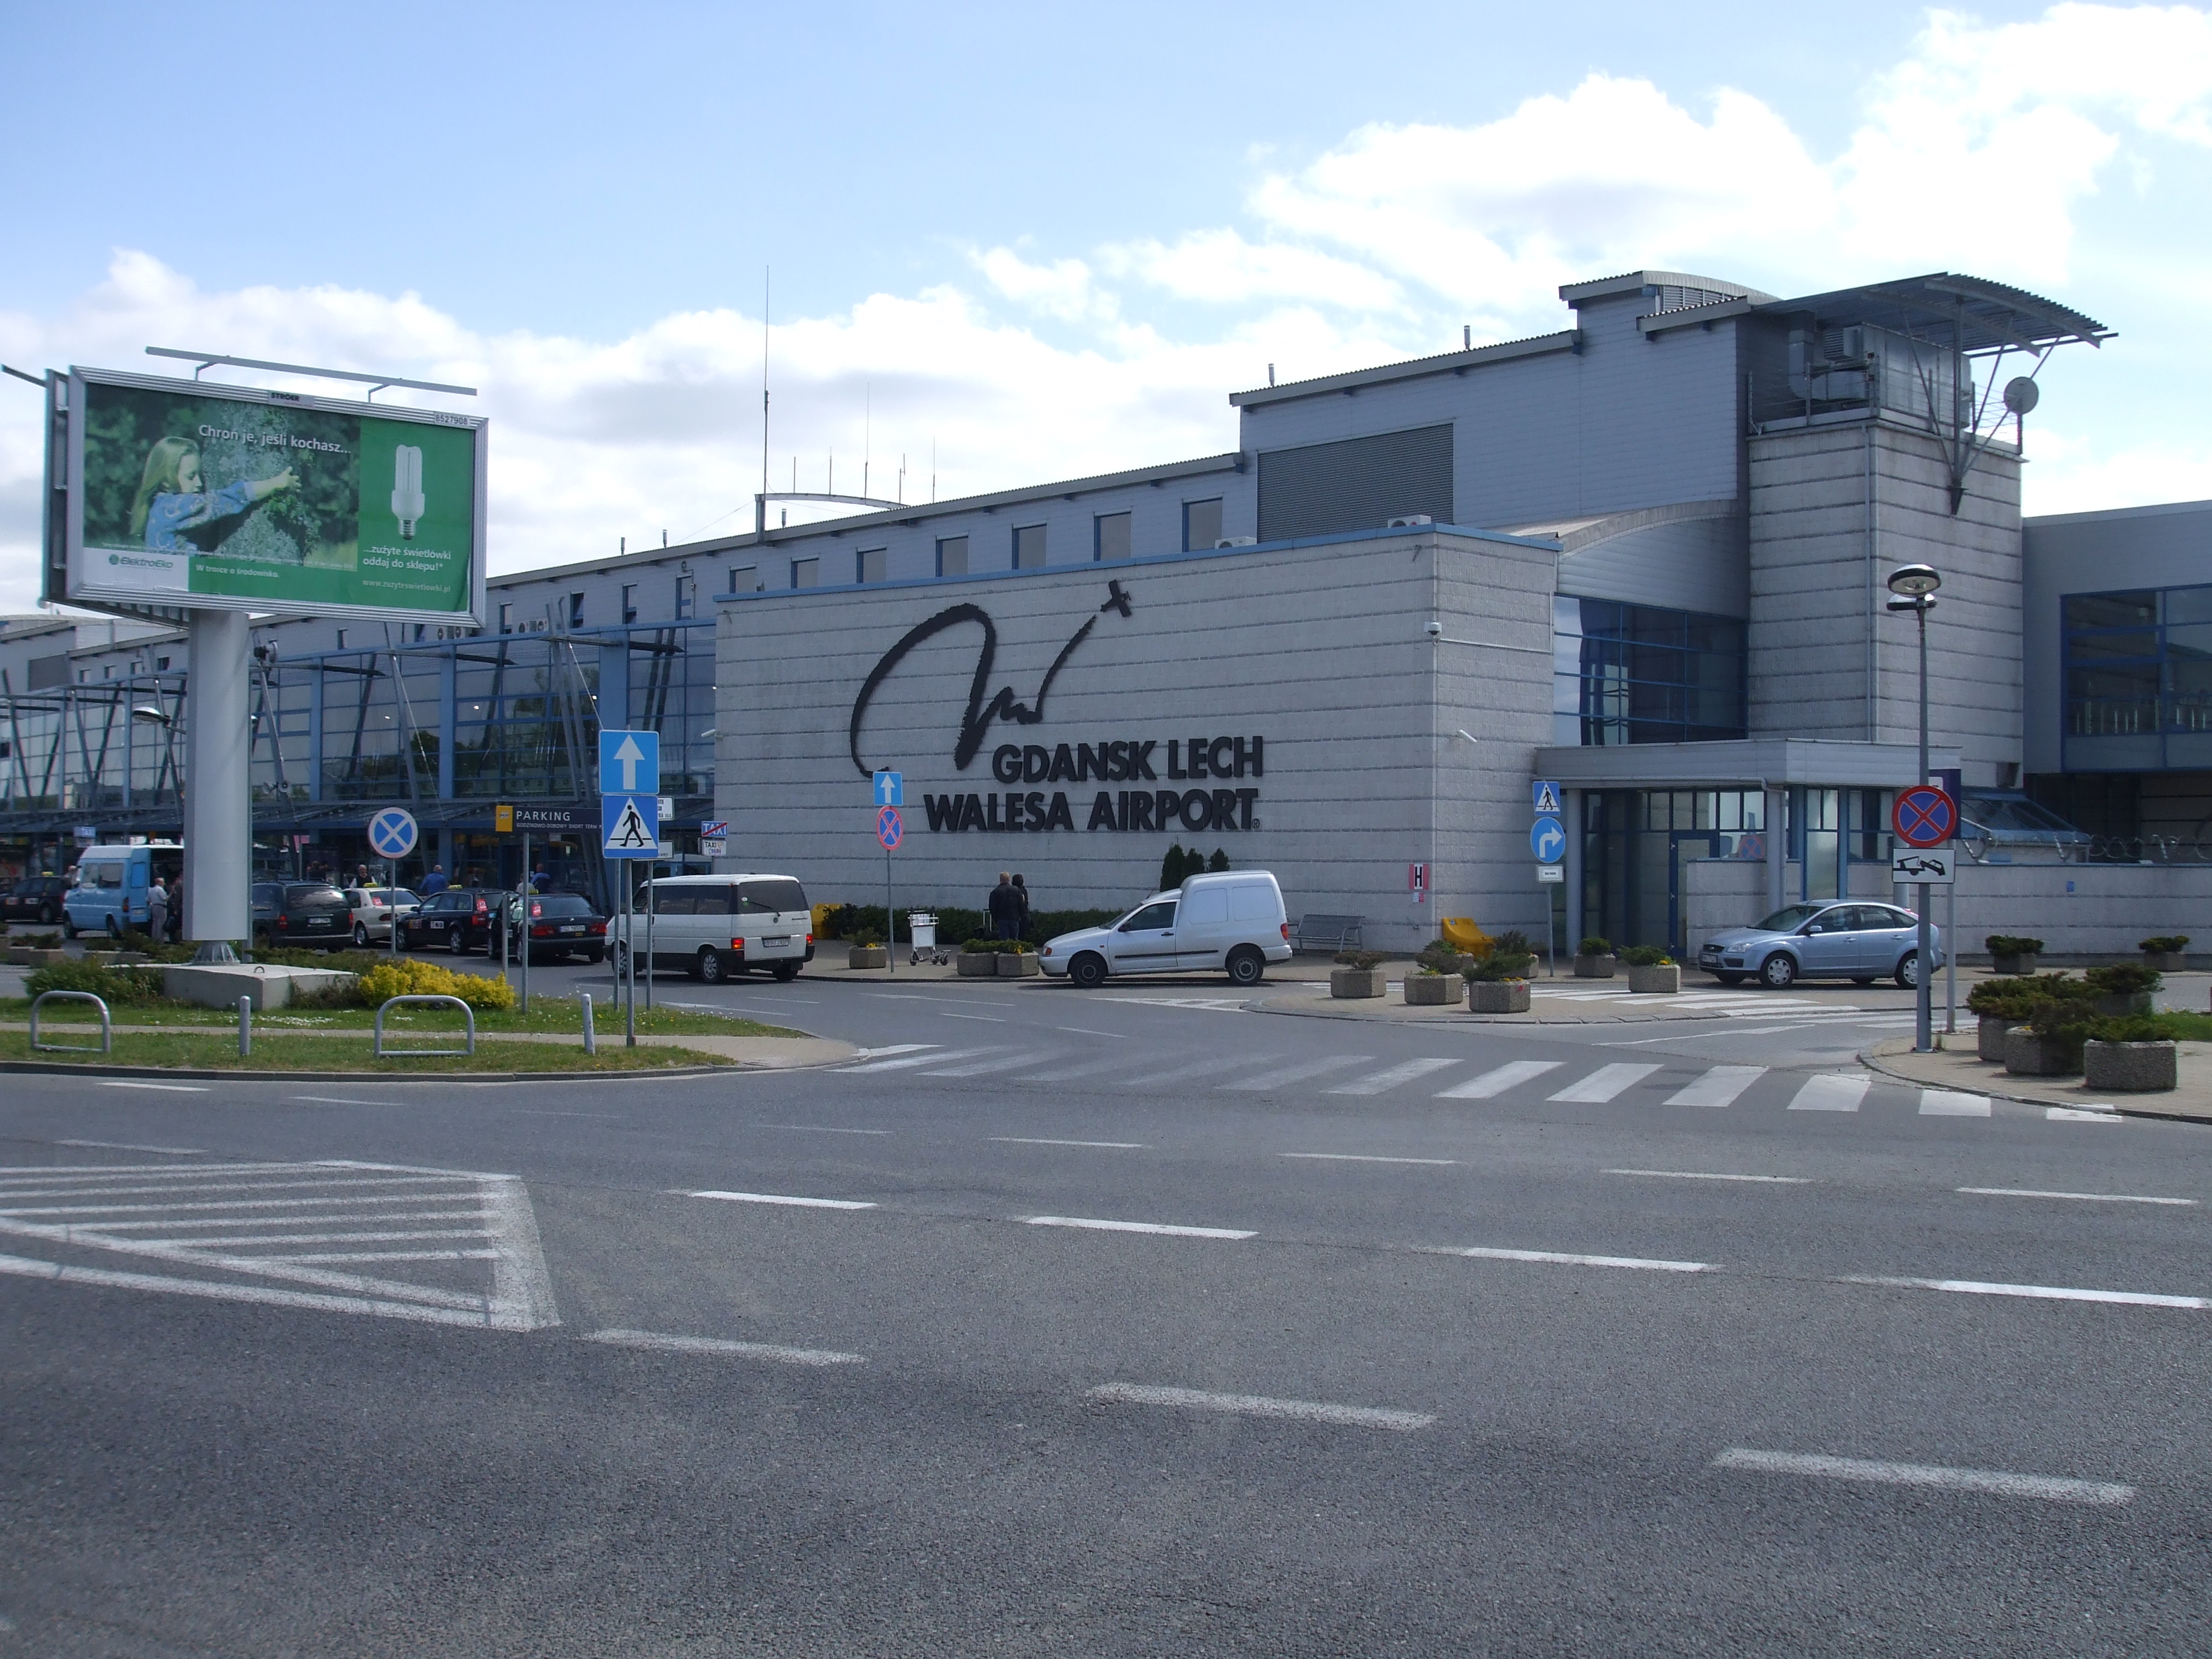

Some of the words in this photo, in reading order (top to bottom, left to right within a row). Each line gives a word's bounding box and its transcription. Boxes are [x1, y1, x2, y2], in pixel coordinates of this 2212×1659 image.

[436, 415, 468, 425] 8527908
[199, 424, 238, 440] Chroń
[242, 430, 257, 444] je,
[261, 433, 287, 446] jeśli
[291, 436, 351, 454] kochasz...
[121, 556, 173, 568] ElektroEko
[363, 556, 389, 569] oddaj
[392, 559, 404, 568] do
[992, 740, 1157, 783] GDANSK
[1168, 736, 1263, 779] LECH
[516, 811, 570, 821] PARKING
[923, 791, 1074, 832] WALESA
[703, 823, 727, 836] TAXI
[1415, 866, 1423, 887] H
